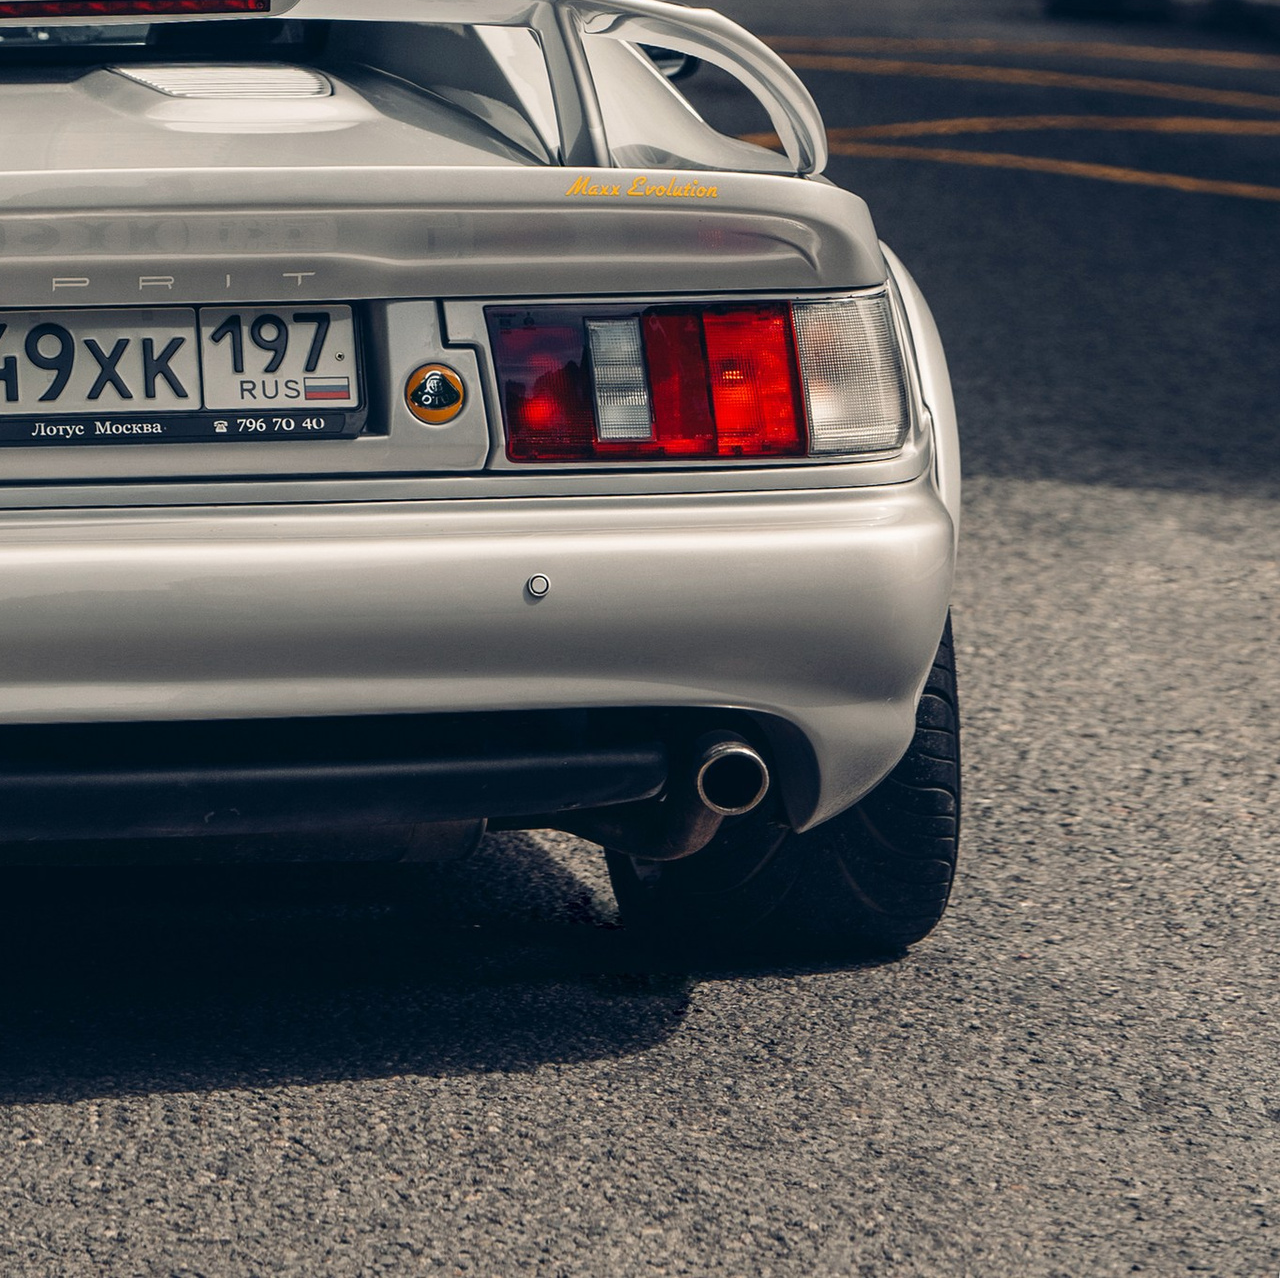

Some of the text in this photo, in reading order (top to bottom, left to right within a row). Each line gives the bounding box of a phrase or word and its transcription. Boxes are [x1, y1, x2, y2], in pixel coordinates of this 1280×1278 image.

[565, 175, 719, 198] Maxx Evolution
[210, 311, 332, 374] 197
[239, 379, 301, 400] RUS
[31, 421, 163, 439] Лотус Москва
[236, 417, 325, 432] 796 70 40
